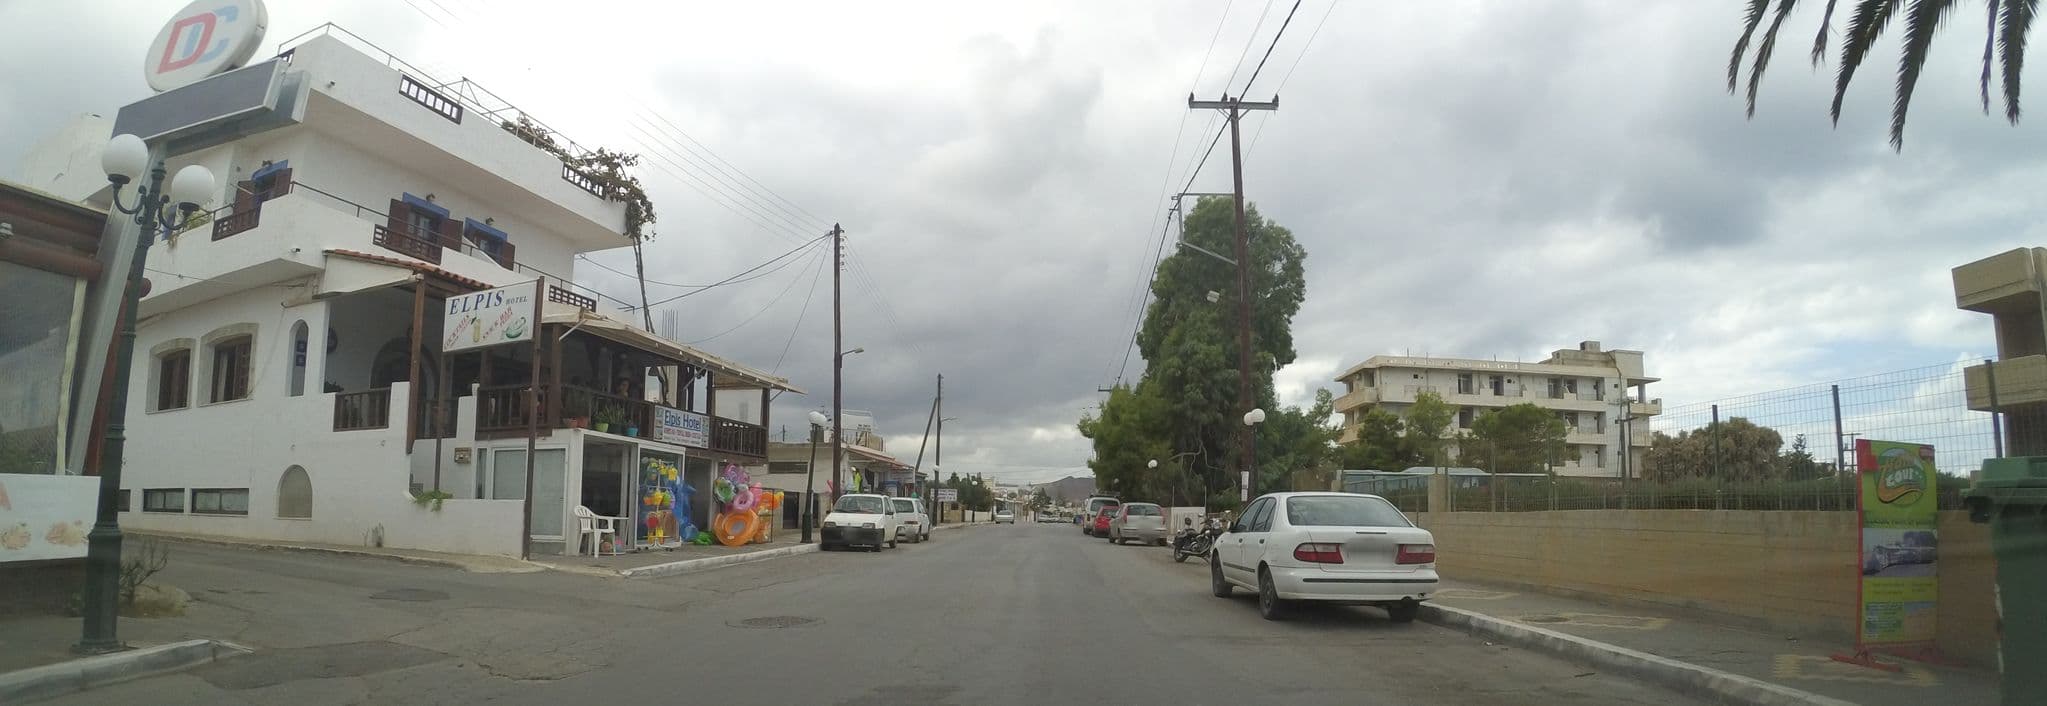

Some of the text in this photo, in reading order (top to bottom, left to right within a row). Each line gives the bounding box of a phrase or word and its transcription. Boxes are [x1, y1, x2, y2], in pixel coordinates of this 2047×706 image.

[449, 290, 528, 315] ELPIS HOTEL
[664, 410, 702, 430] Elpis Hotel
